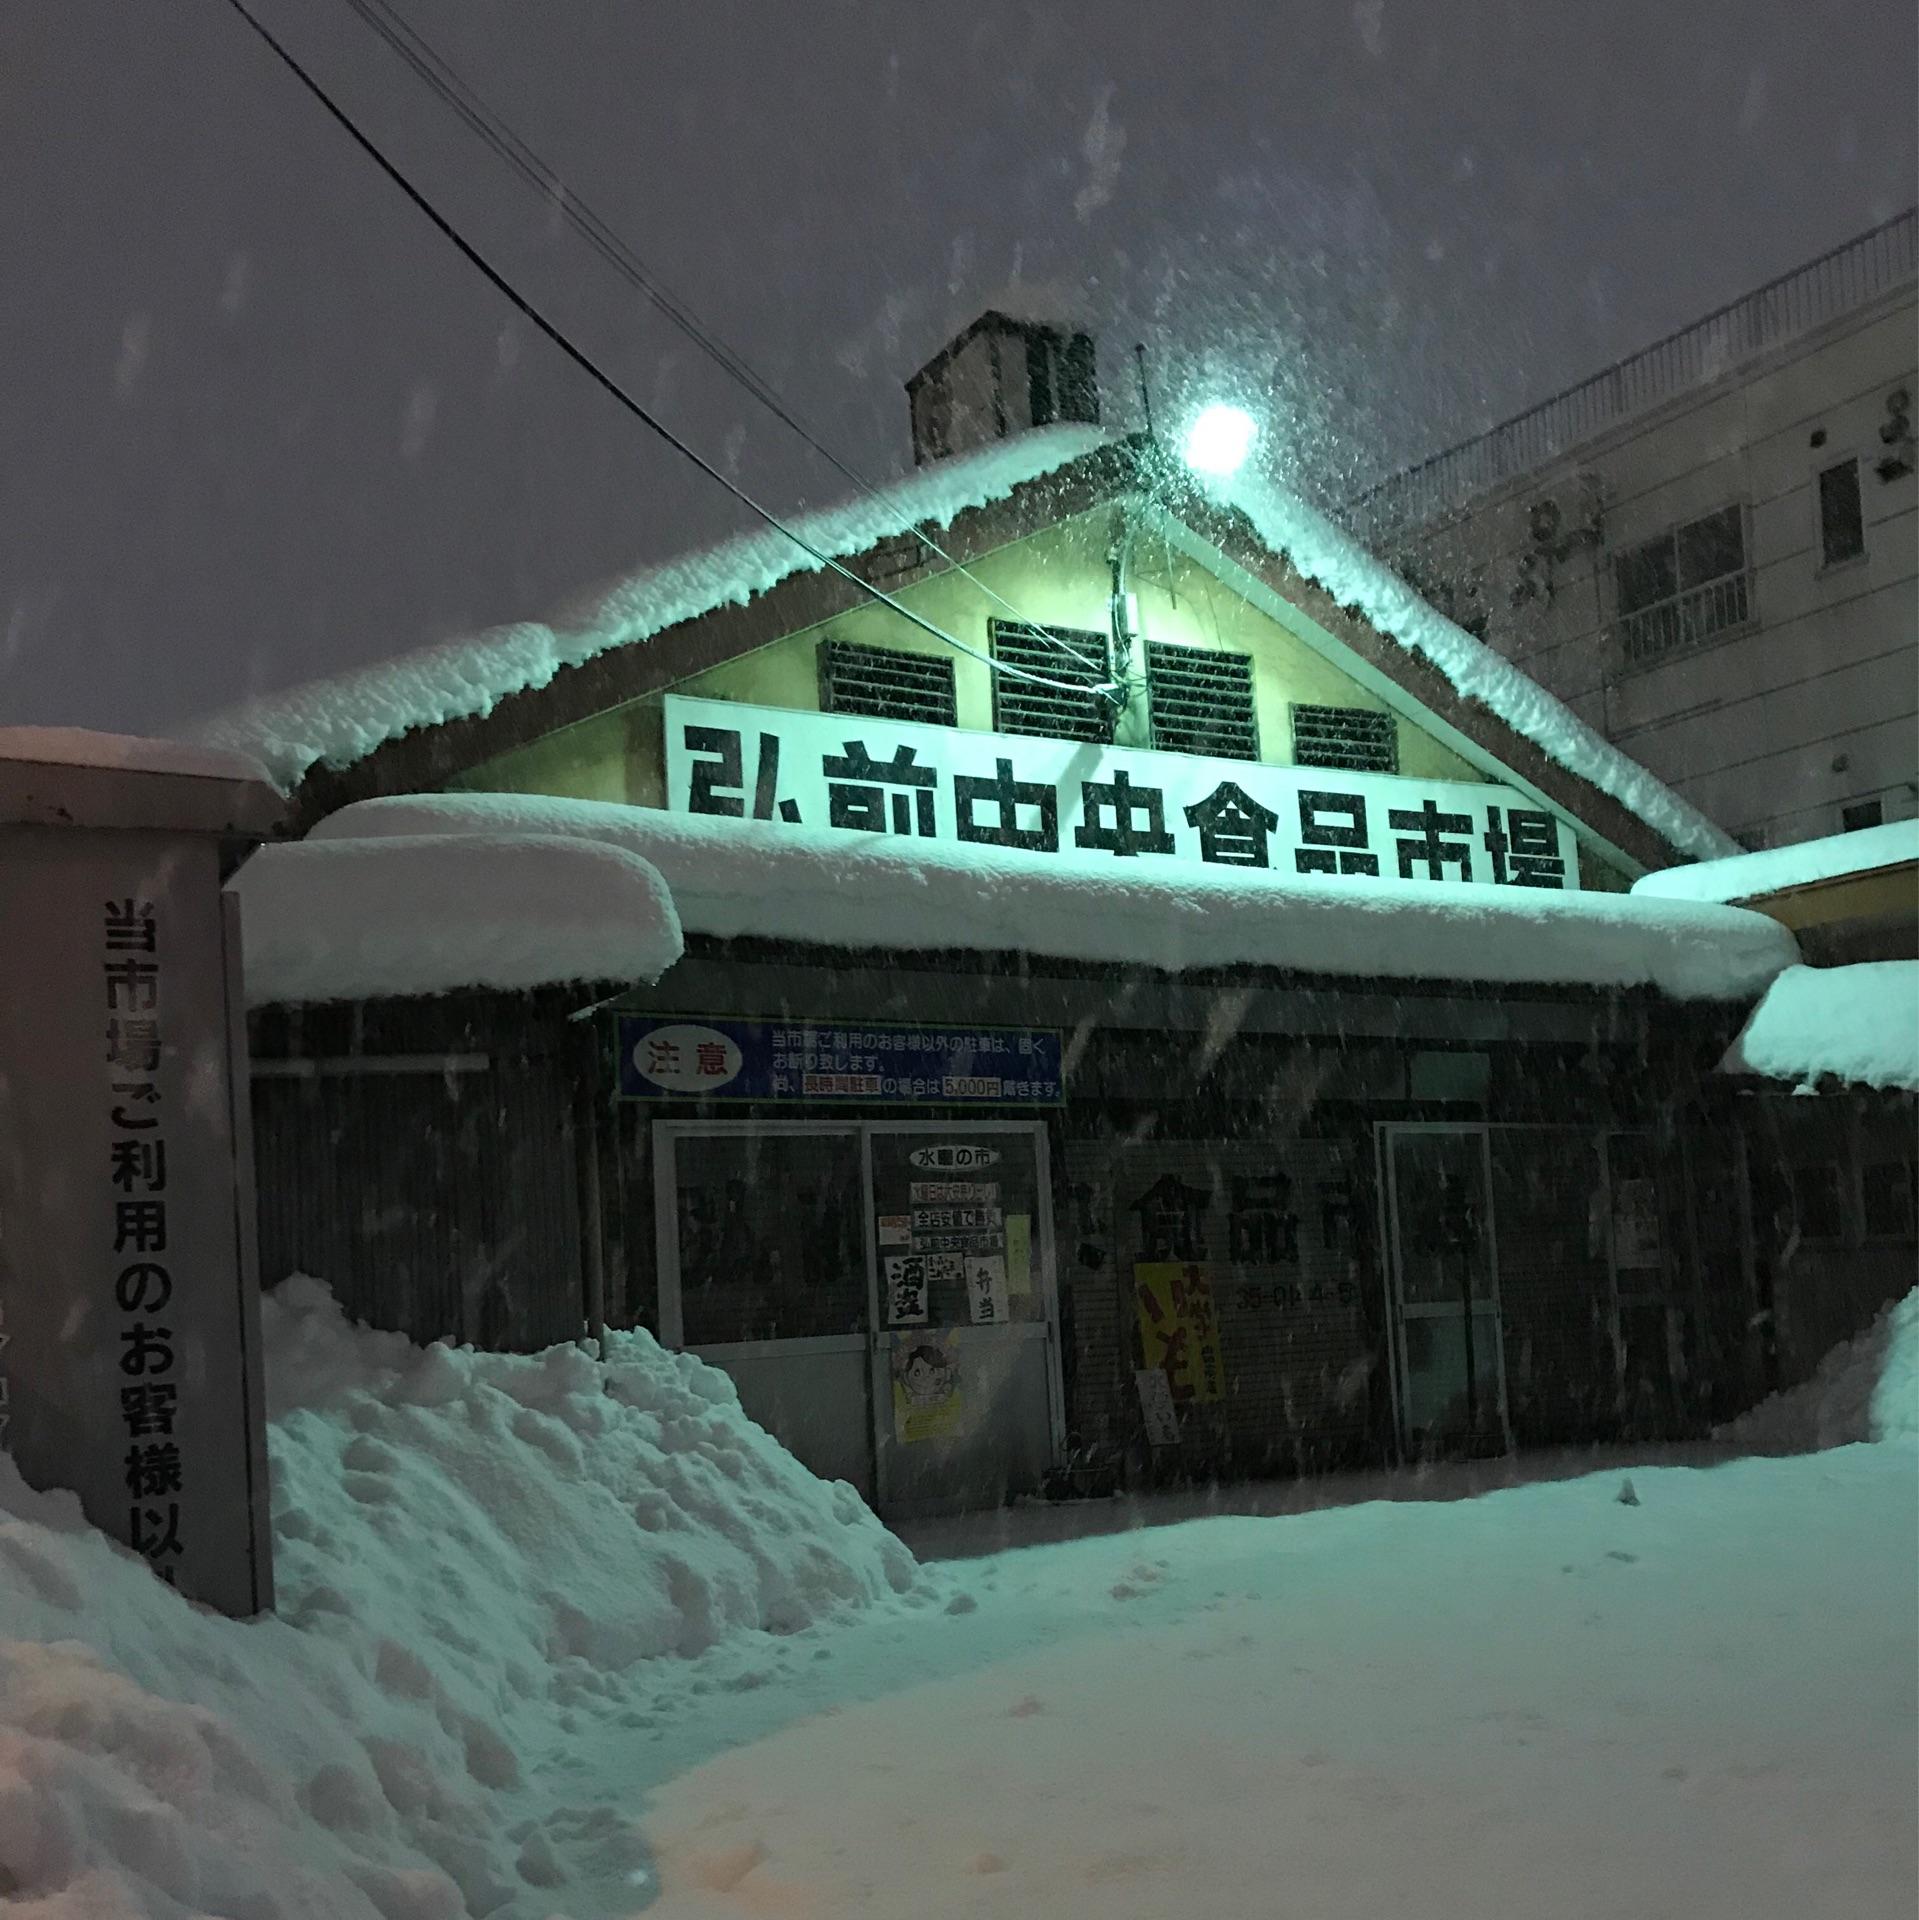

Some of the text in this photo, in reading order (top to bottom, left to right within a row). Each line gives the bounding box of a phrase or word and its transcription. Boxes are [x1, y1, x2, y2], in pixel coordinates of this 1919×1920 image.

[683, 725, 1566, 890] 弘前中央食品市場
[647, 1040, 729, 1076] 注意
[772, 1051, 886, 1073] お断り致します。
[102, 898, 184, 1586] 当市場ご利用のお客様以
[975, 1267, 995, 1319] 弁当
